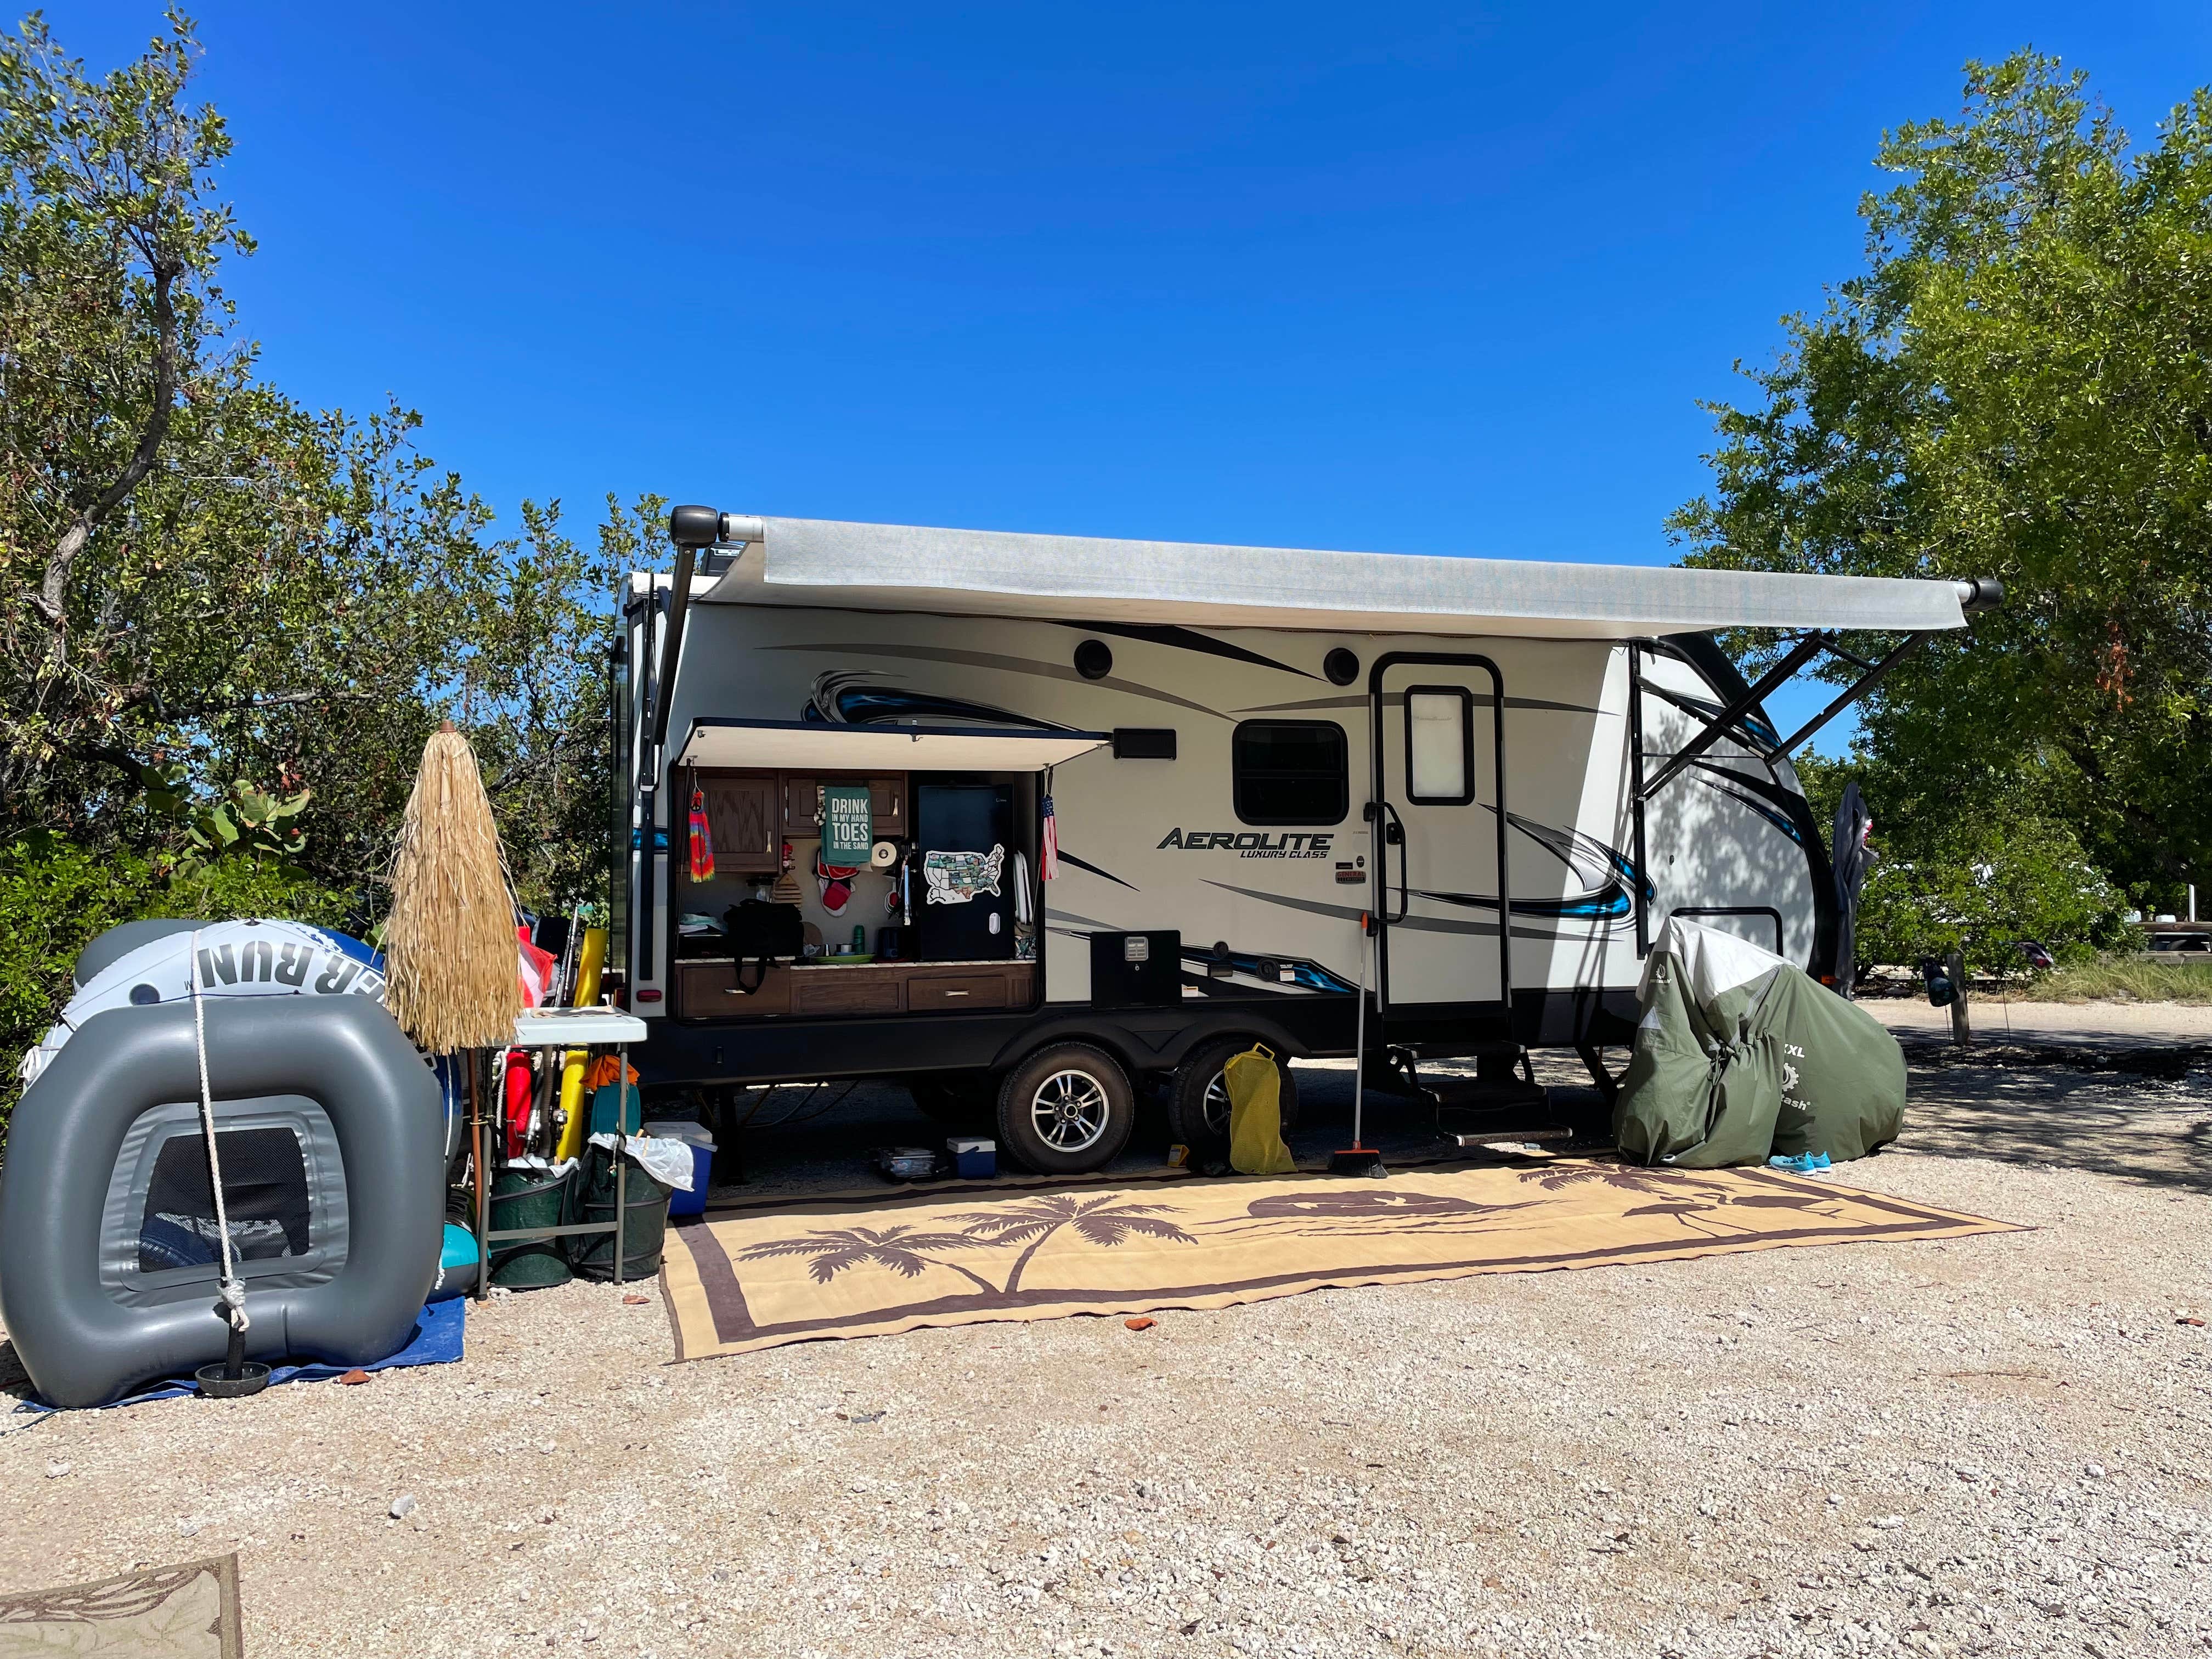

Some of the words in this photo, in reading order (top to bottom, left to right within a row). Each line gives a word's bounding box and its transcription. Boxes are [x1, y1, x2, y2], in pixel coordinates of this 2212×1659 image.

[832, 798, 868, 814] DRINK
[832, 814, 838, 822] IN
[839, 814, 850, 822] MY
[851, 814, 868, 822] HAND
[832, 822, 868, 842] TOES
[1156, 827, 1334, 850] AEROLITE
[833, 841, 839, 849] IN
[839, 842, 852, 850] THE
[853, 842, 868, 850] SAND
[198, 941, 314, 988] RUN
[315, 955, 385, 1005] ER
